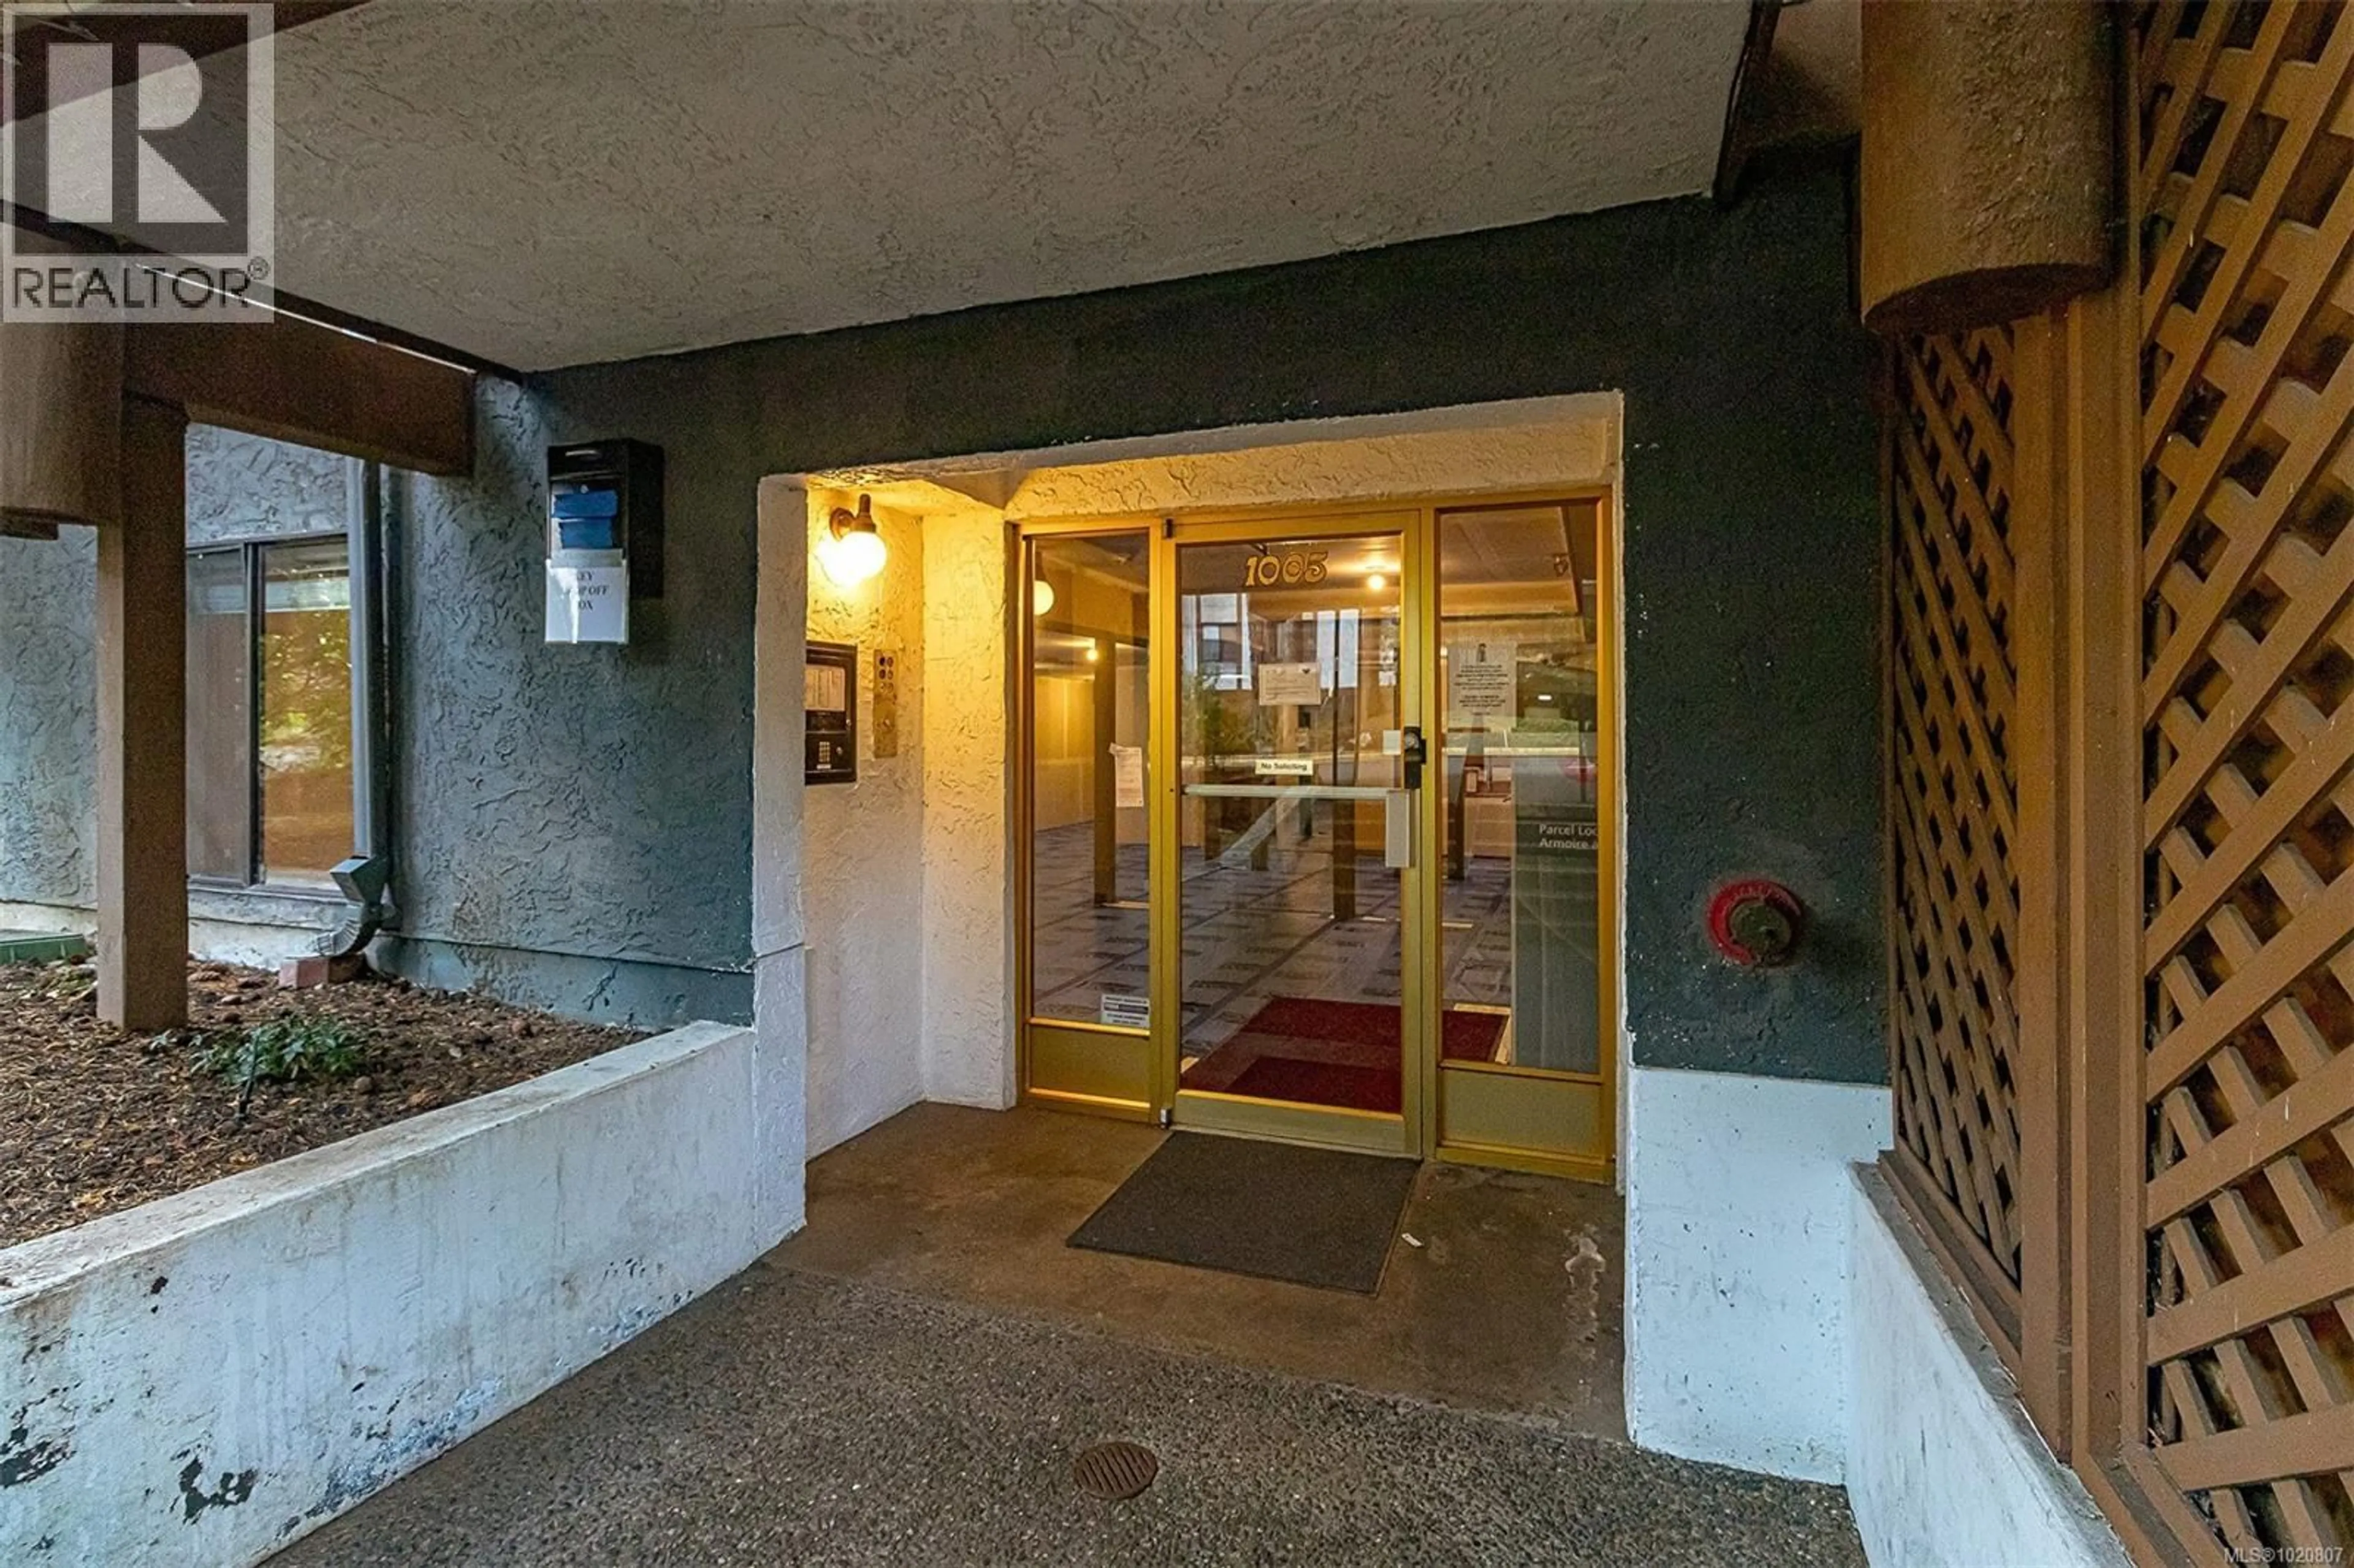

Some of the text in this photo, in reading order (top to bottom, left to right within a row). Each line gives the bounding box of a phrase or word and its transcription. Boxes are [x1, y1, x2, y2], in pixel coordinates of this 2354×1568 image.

[1245, 551, 1329, 587] 1005
[1539, 824, 1575, 835] Parcel
[1539, 838, 1589, 849] Armoire
